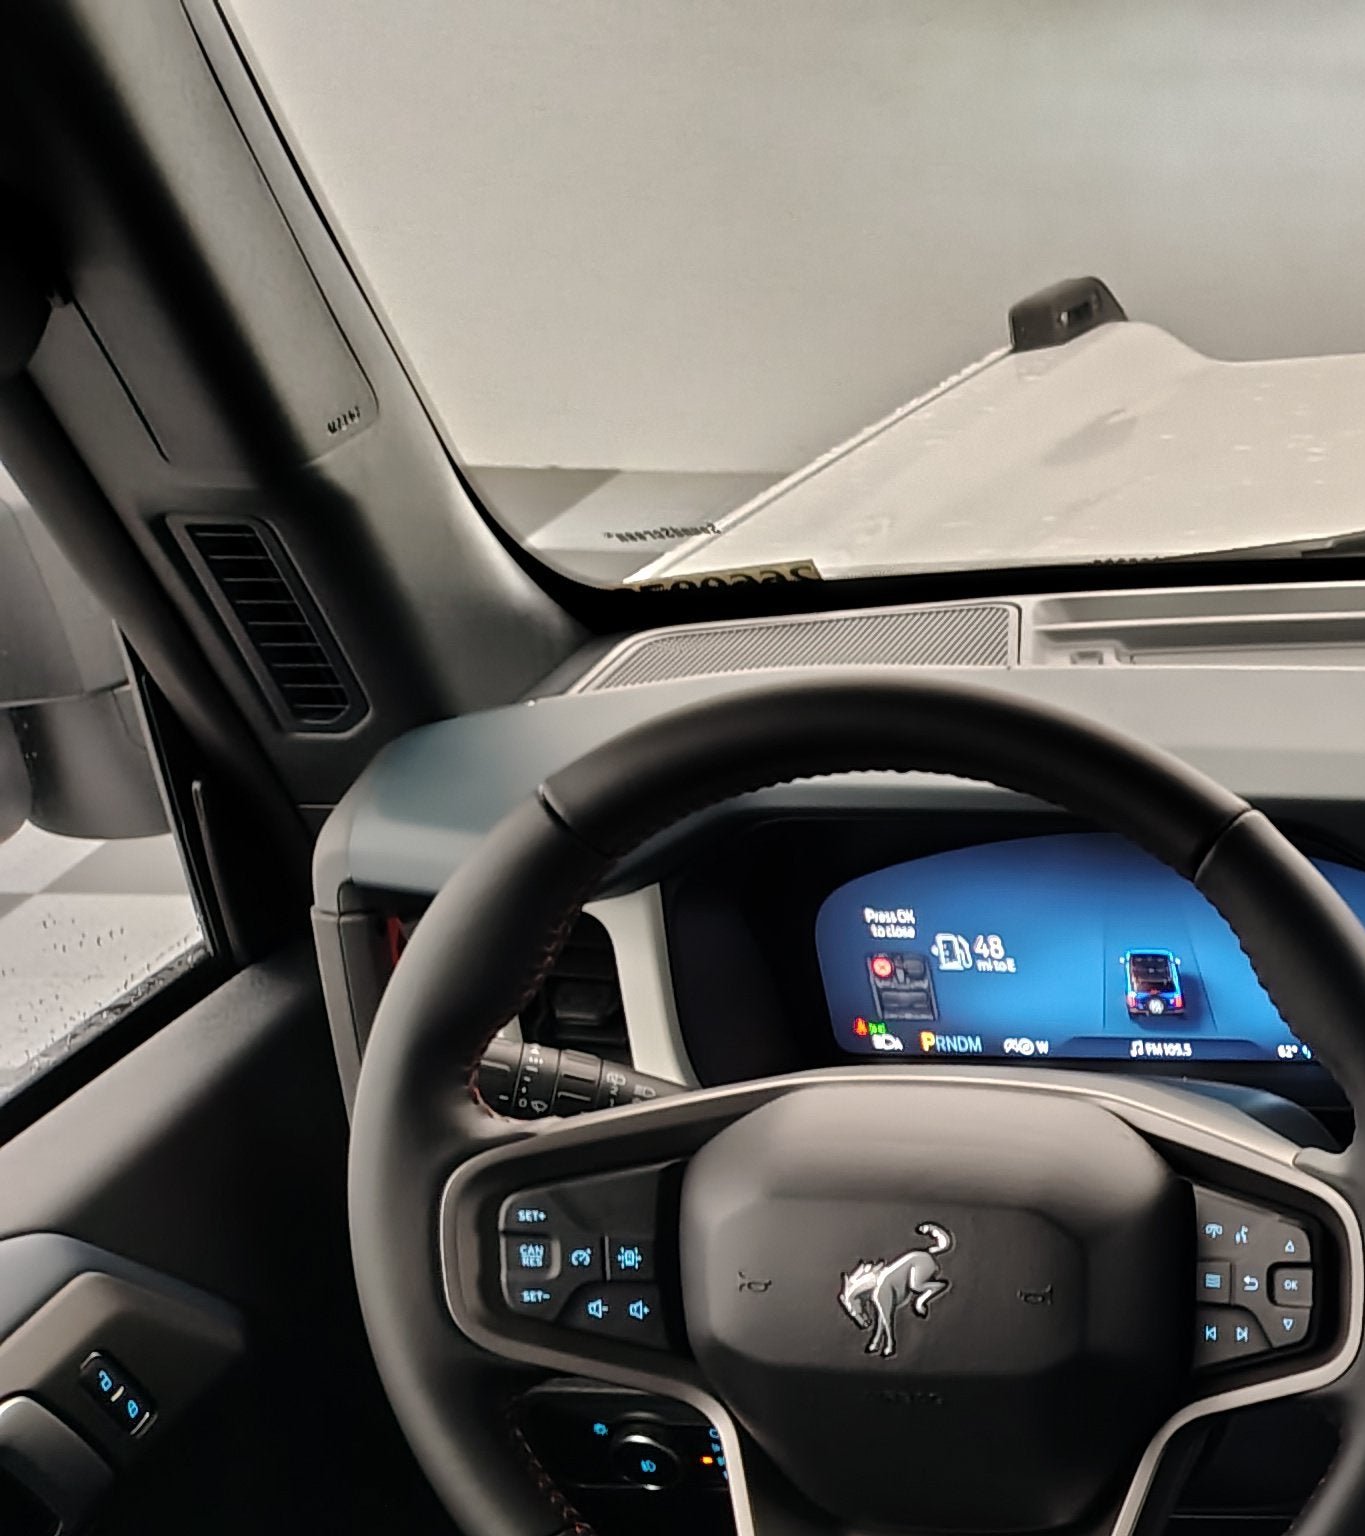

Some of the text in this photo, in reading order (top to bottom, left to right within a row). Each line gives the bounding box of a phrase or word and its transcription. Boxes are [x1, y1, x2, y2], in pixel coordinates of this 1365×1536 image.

[864, 907, 896, 924] Press
[974, 935, 1005, 959] 48
[518, 1209, 547, 1222] SET+
[519, 1243, 544, 1257] CAN
[1283, 1279, 1298, 1291] OK
